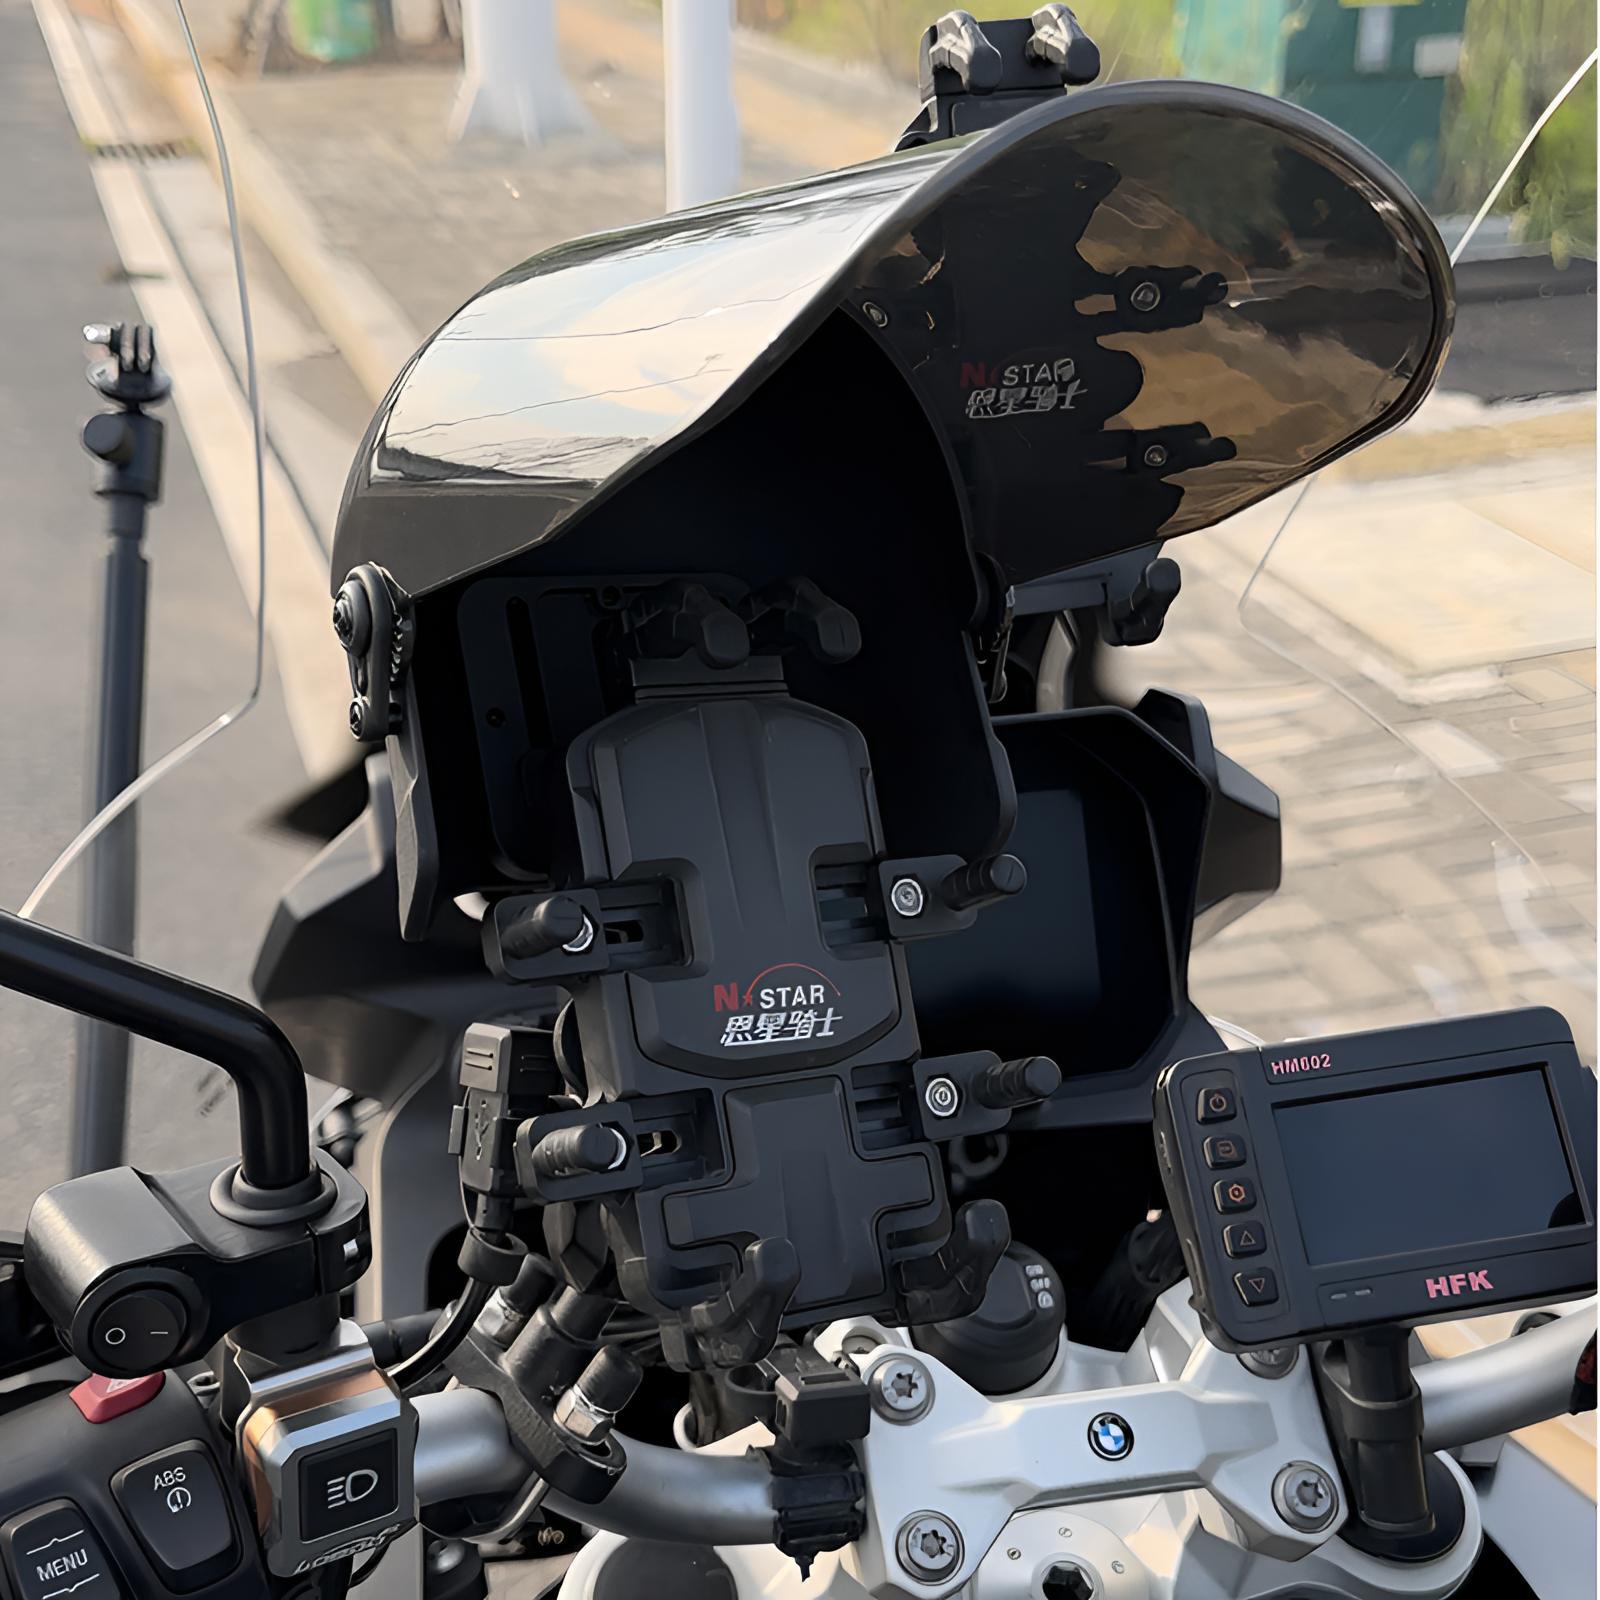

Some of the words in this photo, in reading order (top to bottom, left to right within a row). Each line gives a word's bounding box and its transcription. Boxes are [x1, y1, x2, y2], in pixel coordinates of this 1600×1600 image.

[759, 984, 825, 1009] STAR
[1271, 1053, 1331, 1075] HM002
[1425, 1269, 1494, 1298] HFK
[153, 1466, 186, 1491] ABS
[36, 1548, 89, 1582] MENU
